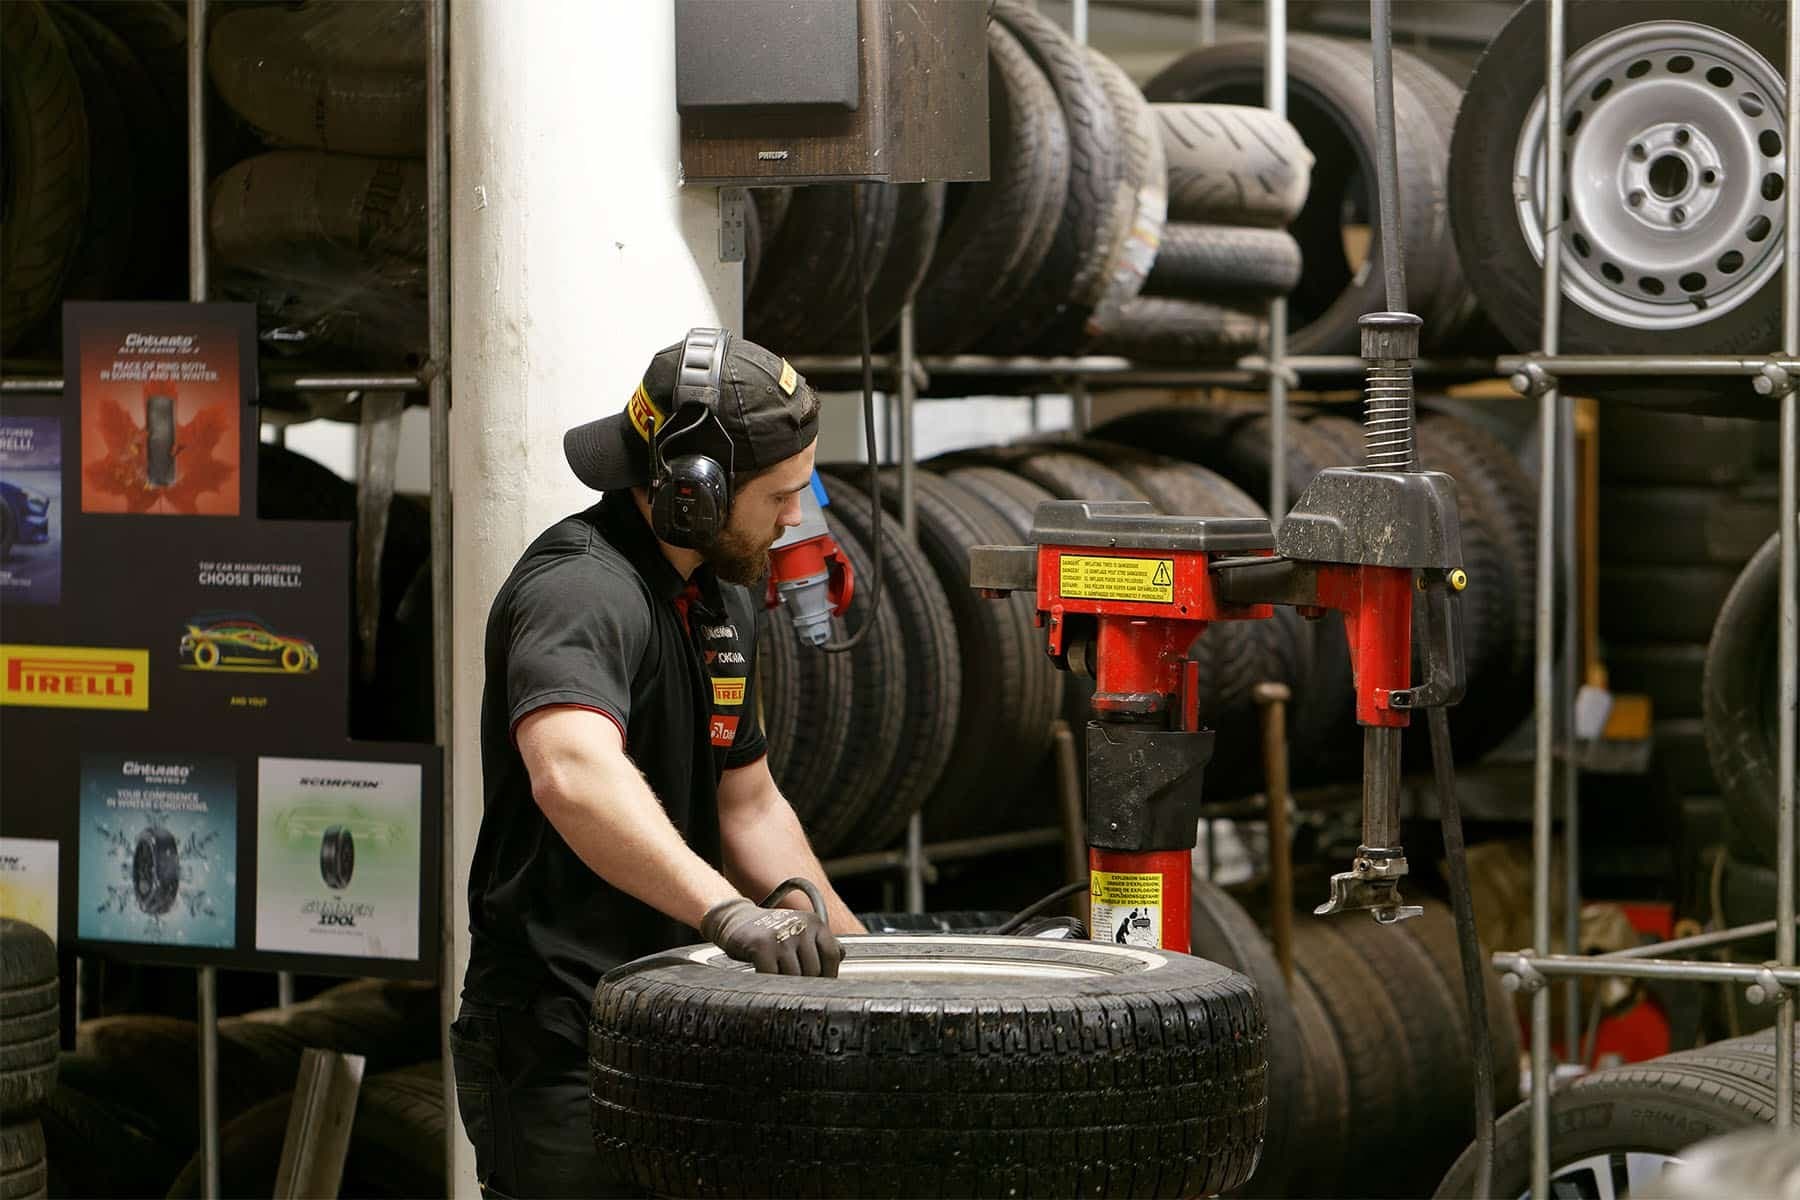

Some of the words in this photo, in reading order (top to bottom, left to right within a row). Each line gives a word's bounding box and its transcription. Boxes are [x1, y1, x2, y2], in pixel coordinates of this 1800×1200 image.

[758, 151, 788, 161] PHILIPS
[199, 572, 250, 586] CHOOSE
[7, 656, 136, 697] PIRELLI
[317, 913, 357, 928] IDOL
